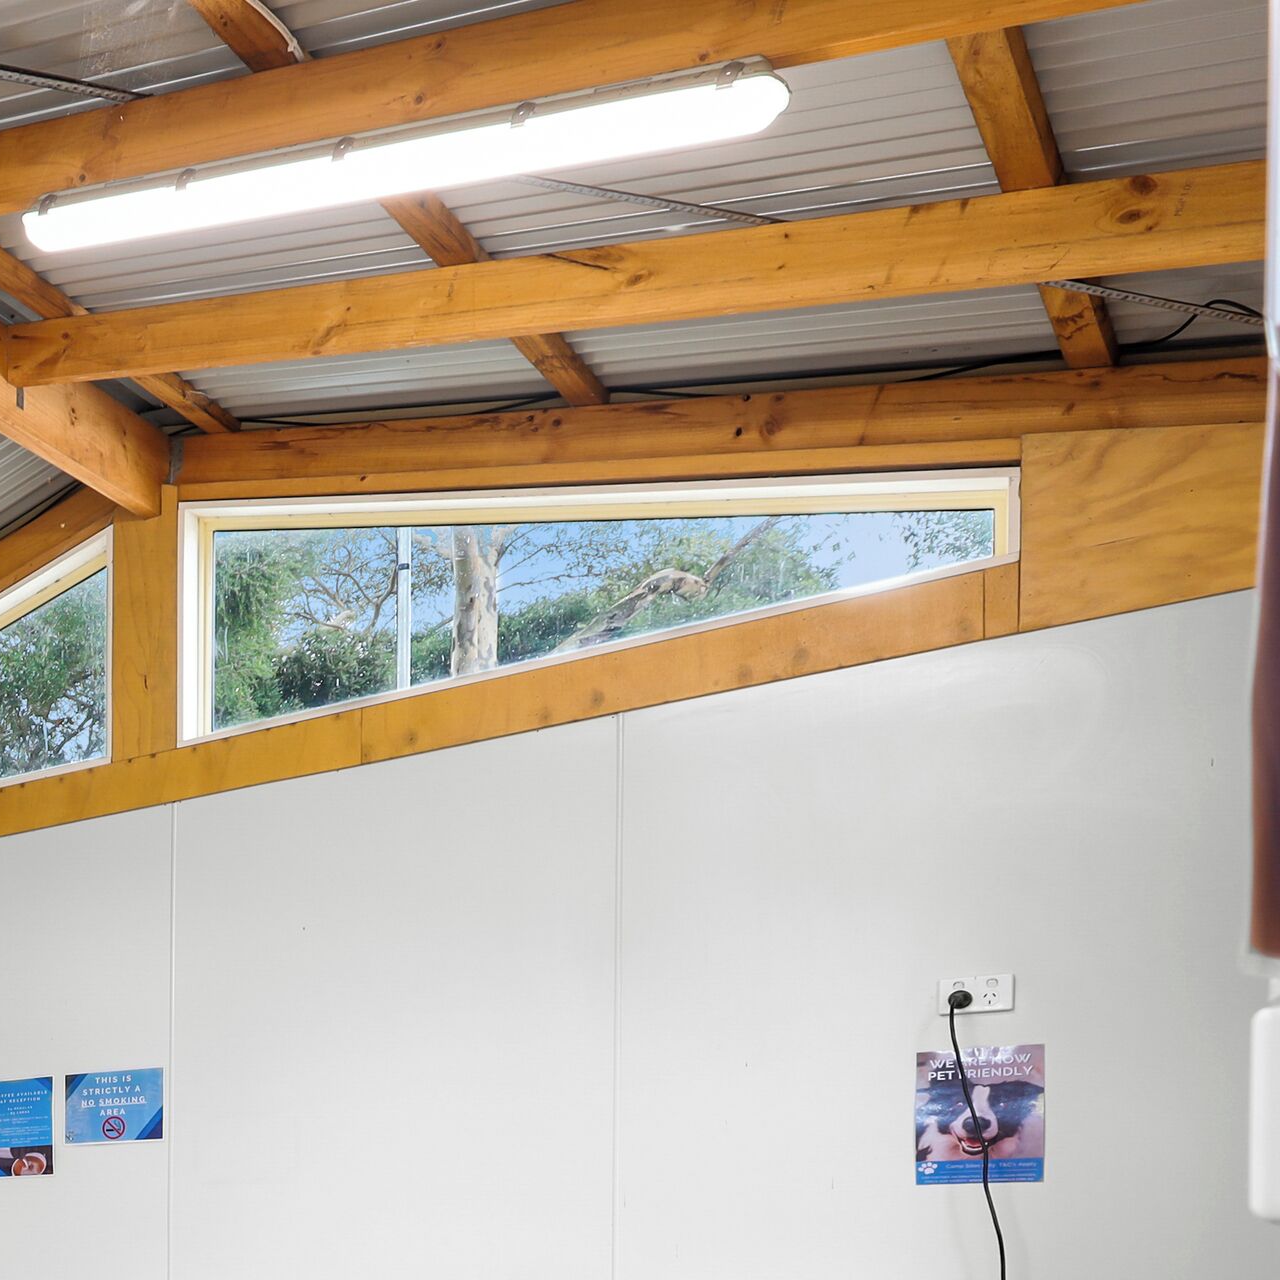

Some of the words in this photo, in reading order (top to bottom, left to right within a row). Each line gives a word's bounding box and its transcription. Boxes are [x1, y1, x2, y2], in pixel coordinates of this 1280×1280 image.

[930, 1059, 954, 1068] WE
[991, 1053, 1031, 1064] NOW
[95, 1076, 118, 1084] THIS
[122, 1074, 132, 1082] IS
[928, 1070, 955, 1081] PET
[82, 1086, 131, 1096] STRICTLY
[81, 1099, 96, 1107] NO
[99, 1095, 146, 1106] SMOKING
[100, 1108, 126, 1116] AREA
